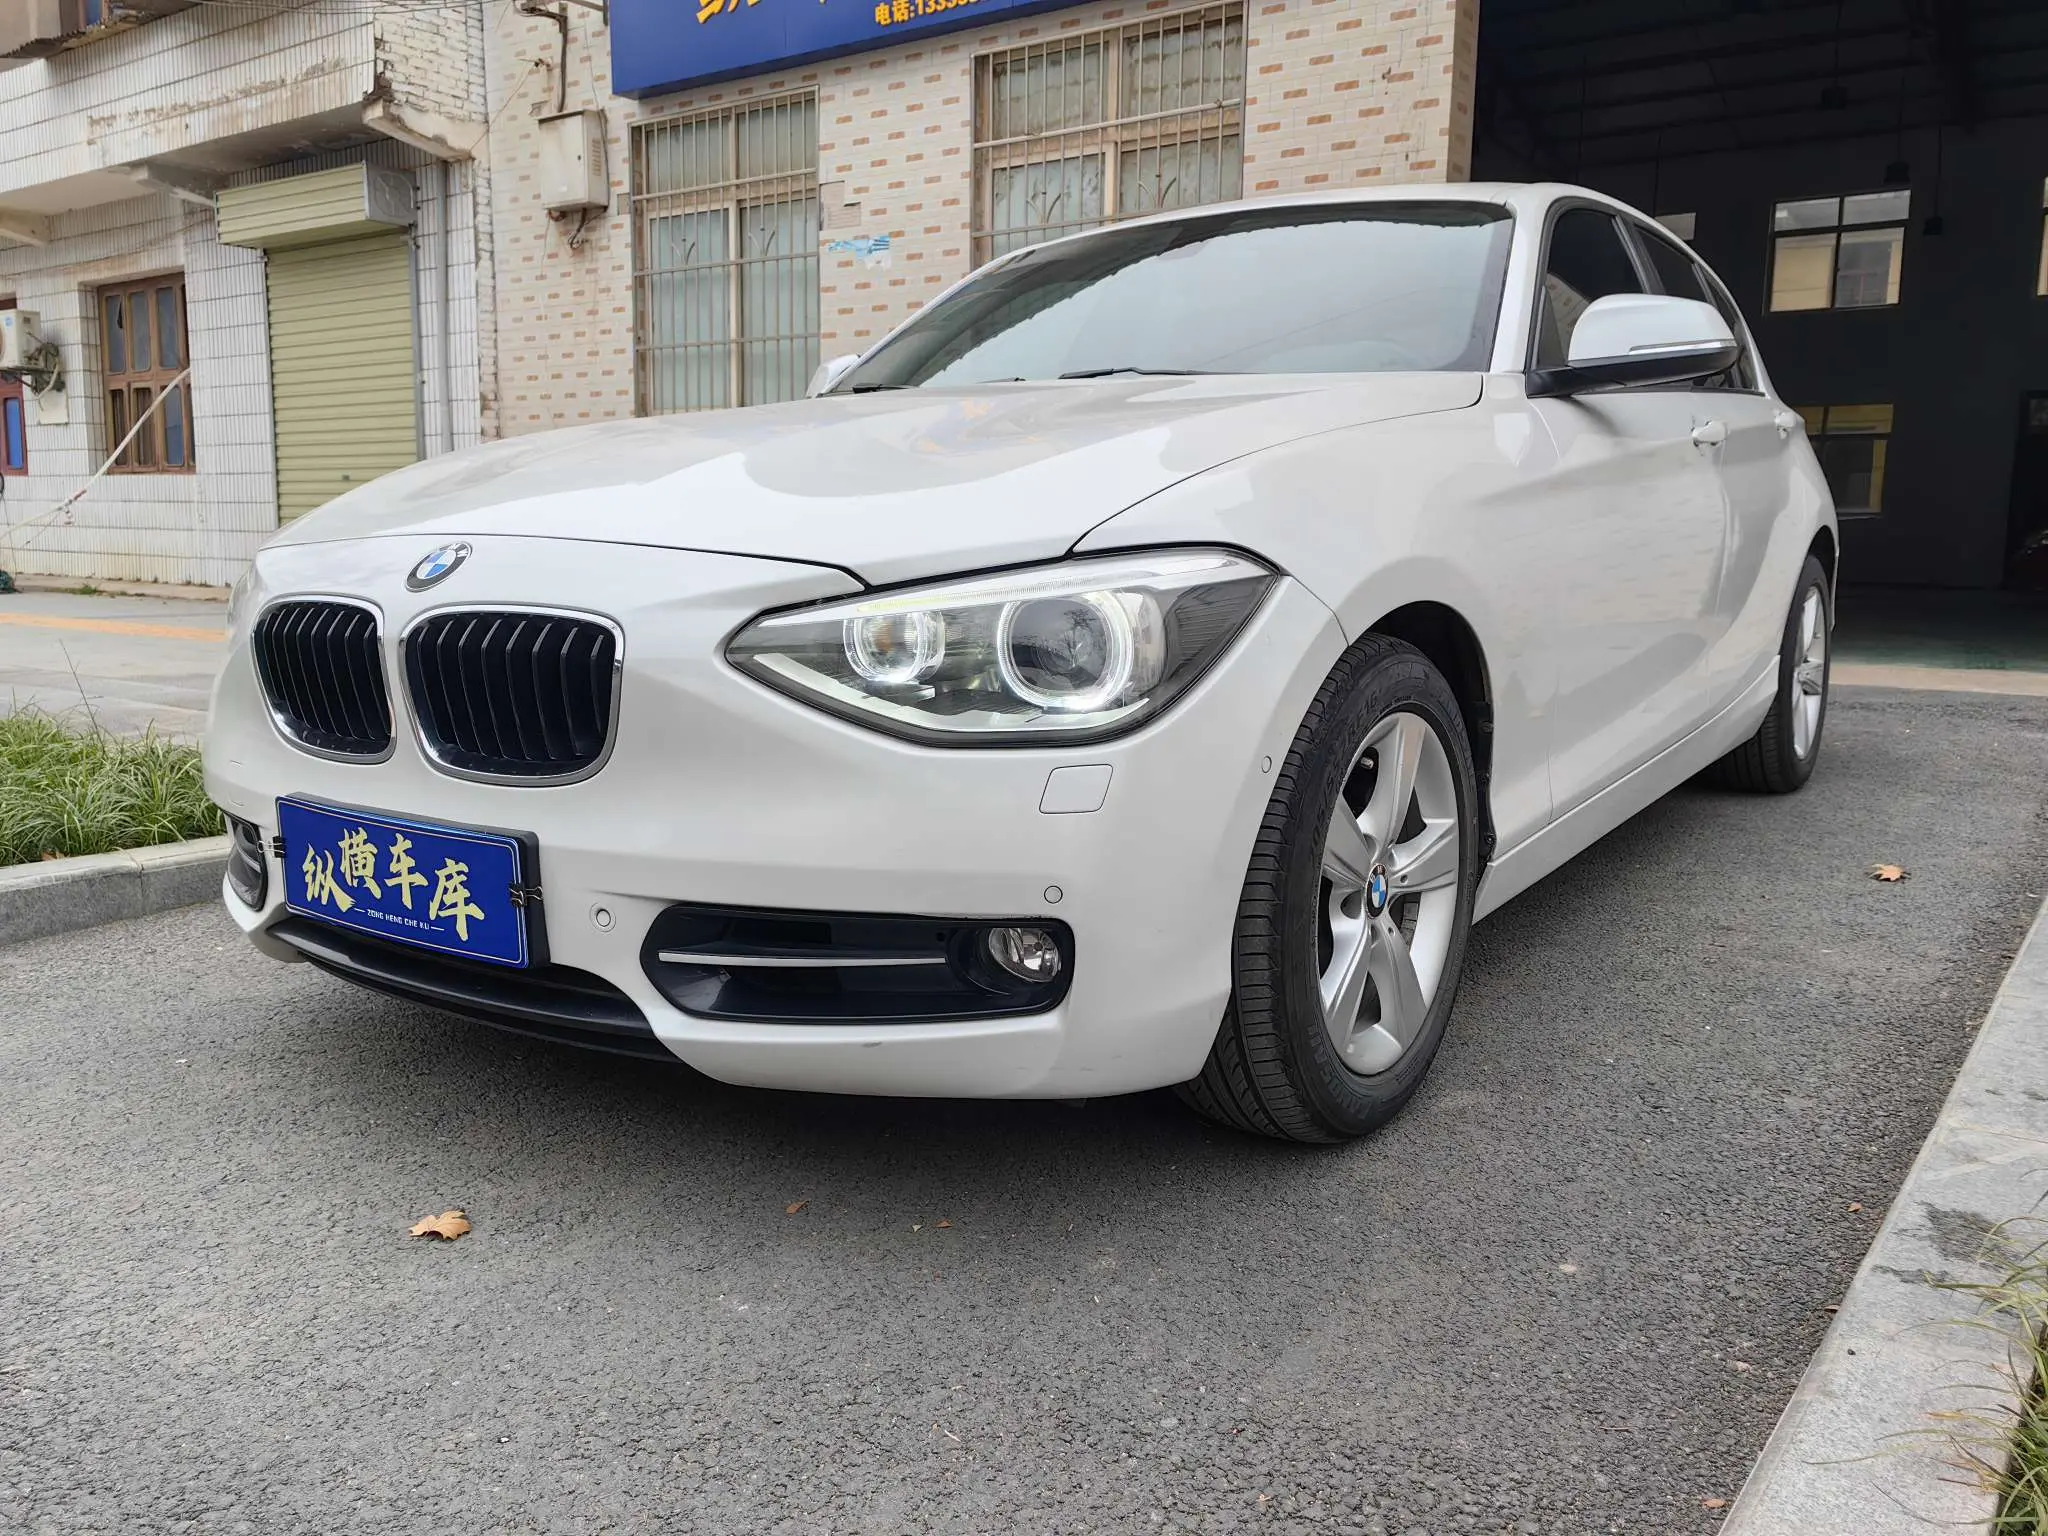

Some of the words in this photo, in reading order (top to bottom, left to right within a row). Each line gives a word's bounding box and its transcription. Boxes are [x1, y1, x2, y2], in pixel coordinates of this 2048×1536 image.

[302, 827, 485, 941] 纵横车库
[367, 909, 384, 920] ZONG
[385, 913, 403, 925] HENG
[404, 918, 418, 928] CHE
[419, 922, 430, 930] KU
